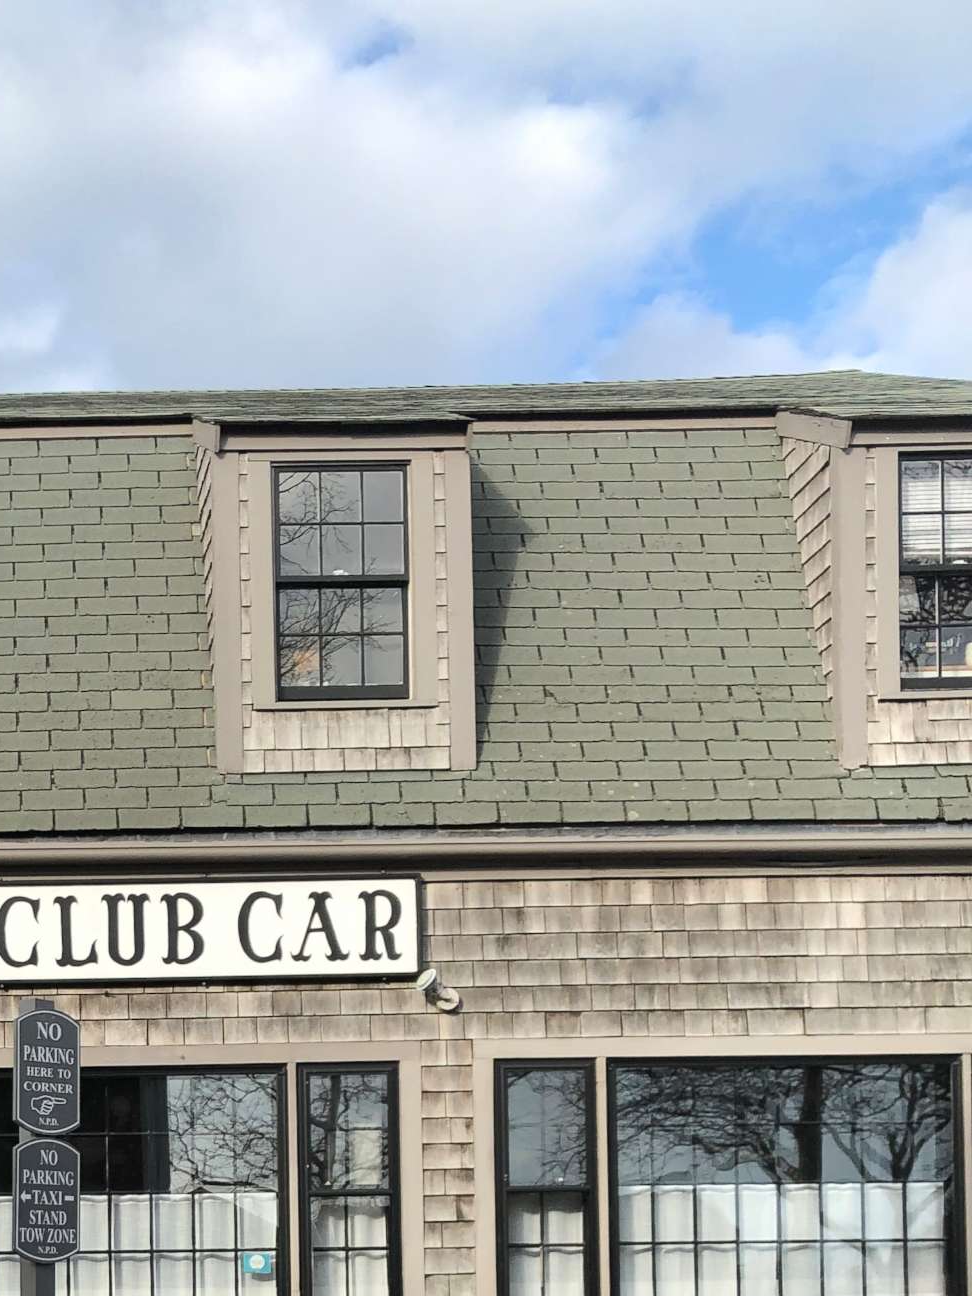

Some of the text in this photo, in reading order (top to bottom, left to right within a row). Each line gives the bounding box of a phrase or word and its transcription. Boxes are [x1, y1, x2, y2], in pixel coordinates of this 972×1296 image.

[237, 890, 403, 963] CAR
[36, 1022, 62, 1040] NO
[23, 1045, 75, 1065] PARKING
[27, 1066, 71, 1079] HERE TO
[23, 1081, 74, 1094] CORNER
[39, 1118, 59, 1126] N.P.D.
[40, 1150, 58, 1166] NO
[23, 1169, 74, 1186] PARKING
[32, 1190, 63, 1206] TAXI
[29, 1210, 67, 1225] STAND
[20, 1227, 76, 1243] TOW ZONE
[38, 1246, 59, 1254] N.P.D.
